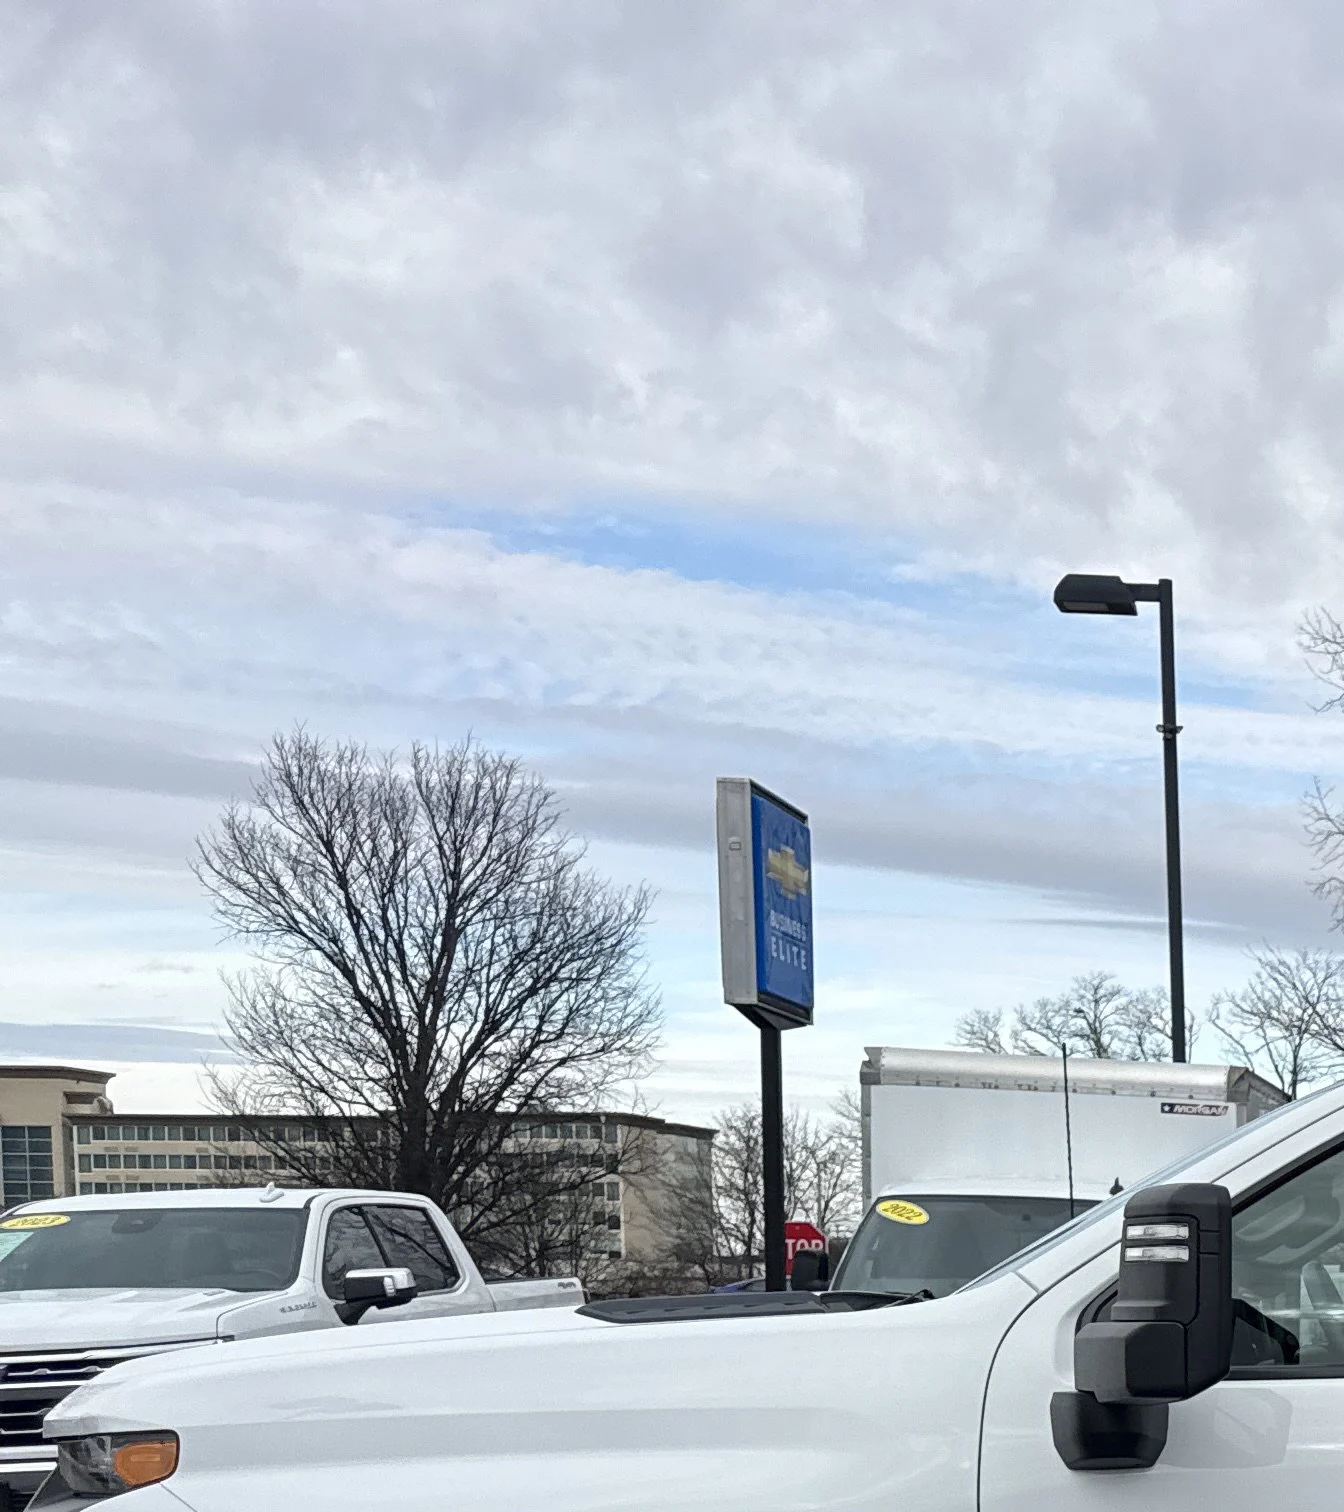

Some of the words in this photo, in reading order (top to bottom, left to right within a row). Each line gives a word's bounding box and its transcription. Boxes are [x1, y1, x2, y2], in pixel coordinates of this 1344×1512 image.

[771, 935, 807, 970] ELITE
[1172, 1104, 1228, 1115] MORGAN
[882, 1203, 923, 1221] 2022
[785, 1238, 824, 1260] TOP
